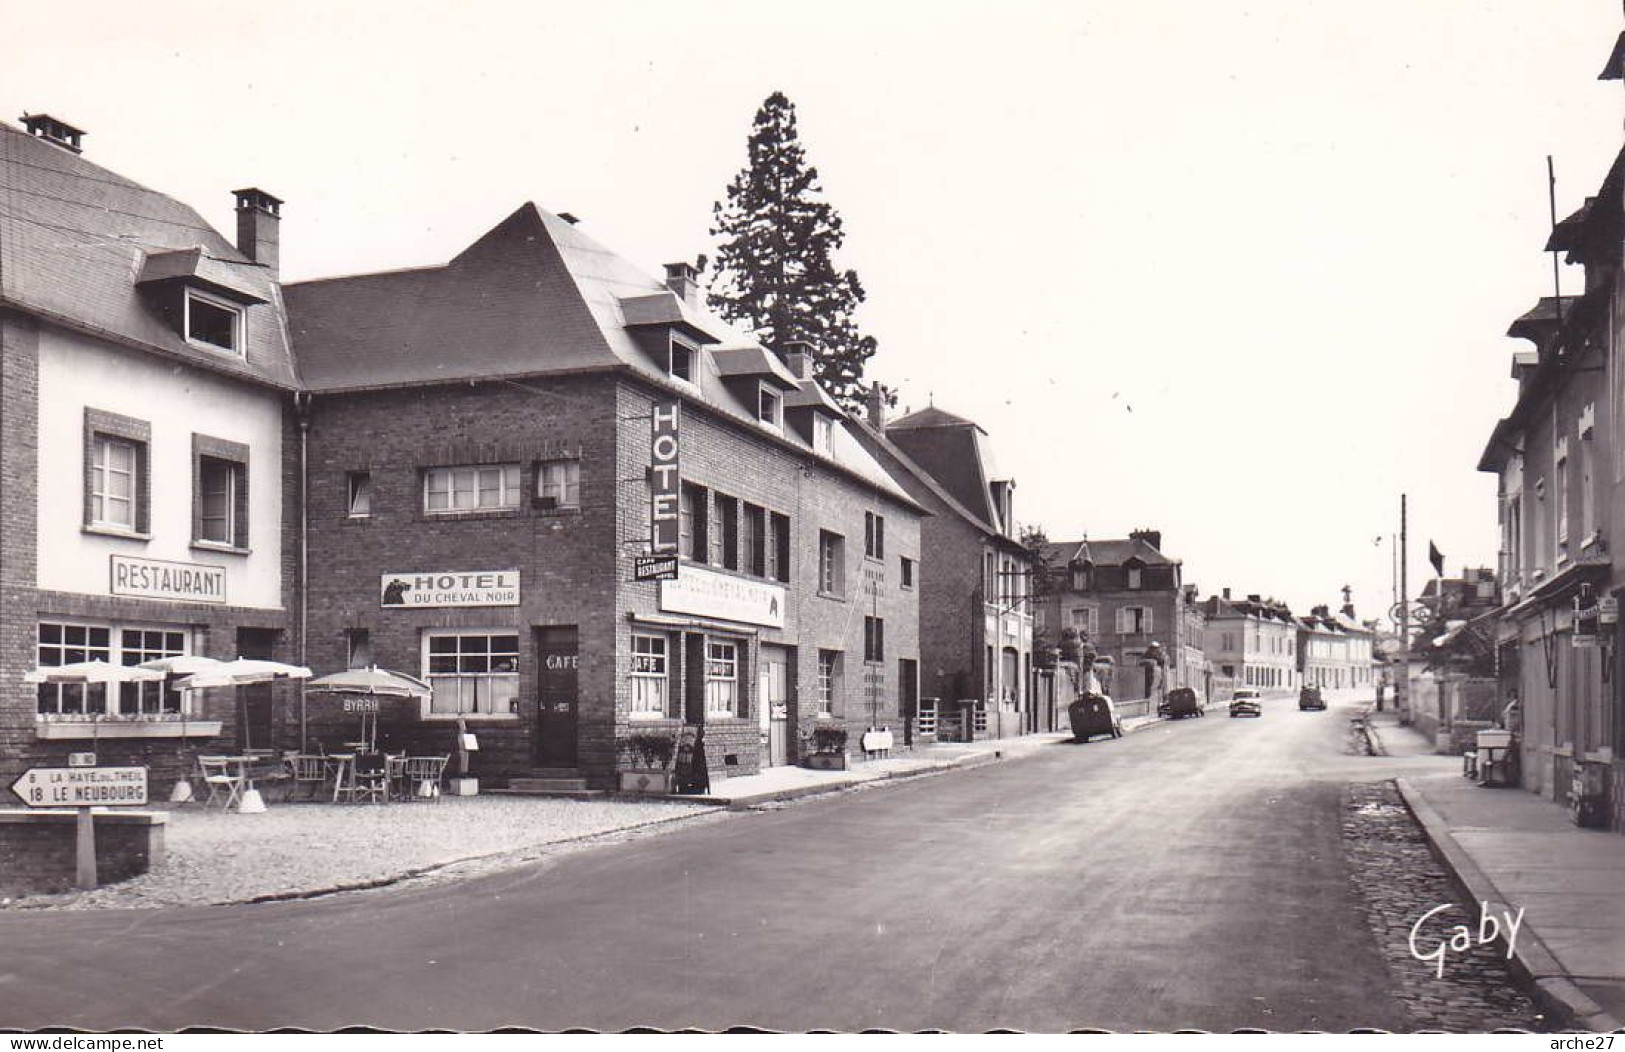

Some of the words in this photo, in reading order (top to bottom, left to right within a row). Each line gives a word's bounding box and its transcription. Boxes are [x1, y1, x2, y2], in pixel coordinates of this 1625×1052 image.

[652, 404, 678, 552] HOTEL
[637, 560, 676, 577] RESTAURANT
[117, 562, 222, 596] RESTAURANT
[414, 593, 432, 604] DU
[435, 591, 480, 603] CHEVAL
[486, 591, 514, 602] NOIR
[343, 698, 379, 712] BYRRH
[51, 773, 63, 784] LA
[69, 772, 96, 783] HAYE
[30, 787, 43, 802] 18
[53, 787, 68, 801] LE
[75, 785, 144, 801] NEUBOURG
